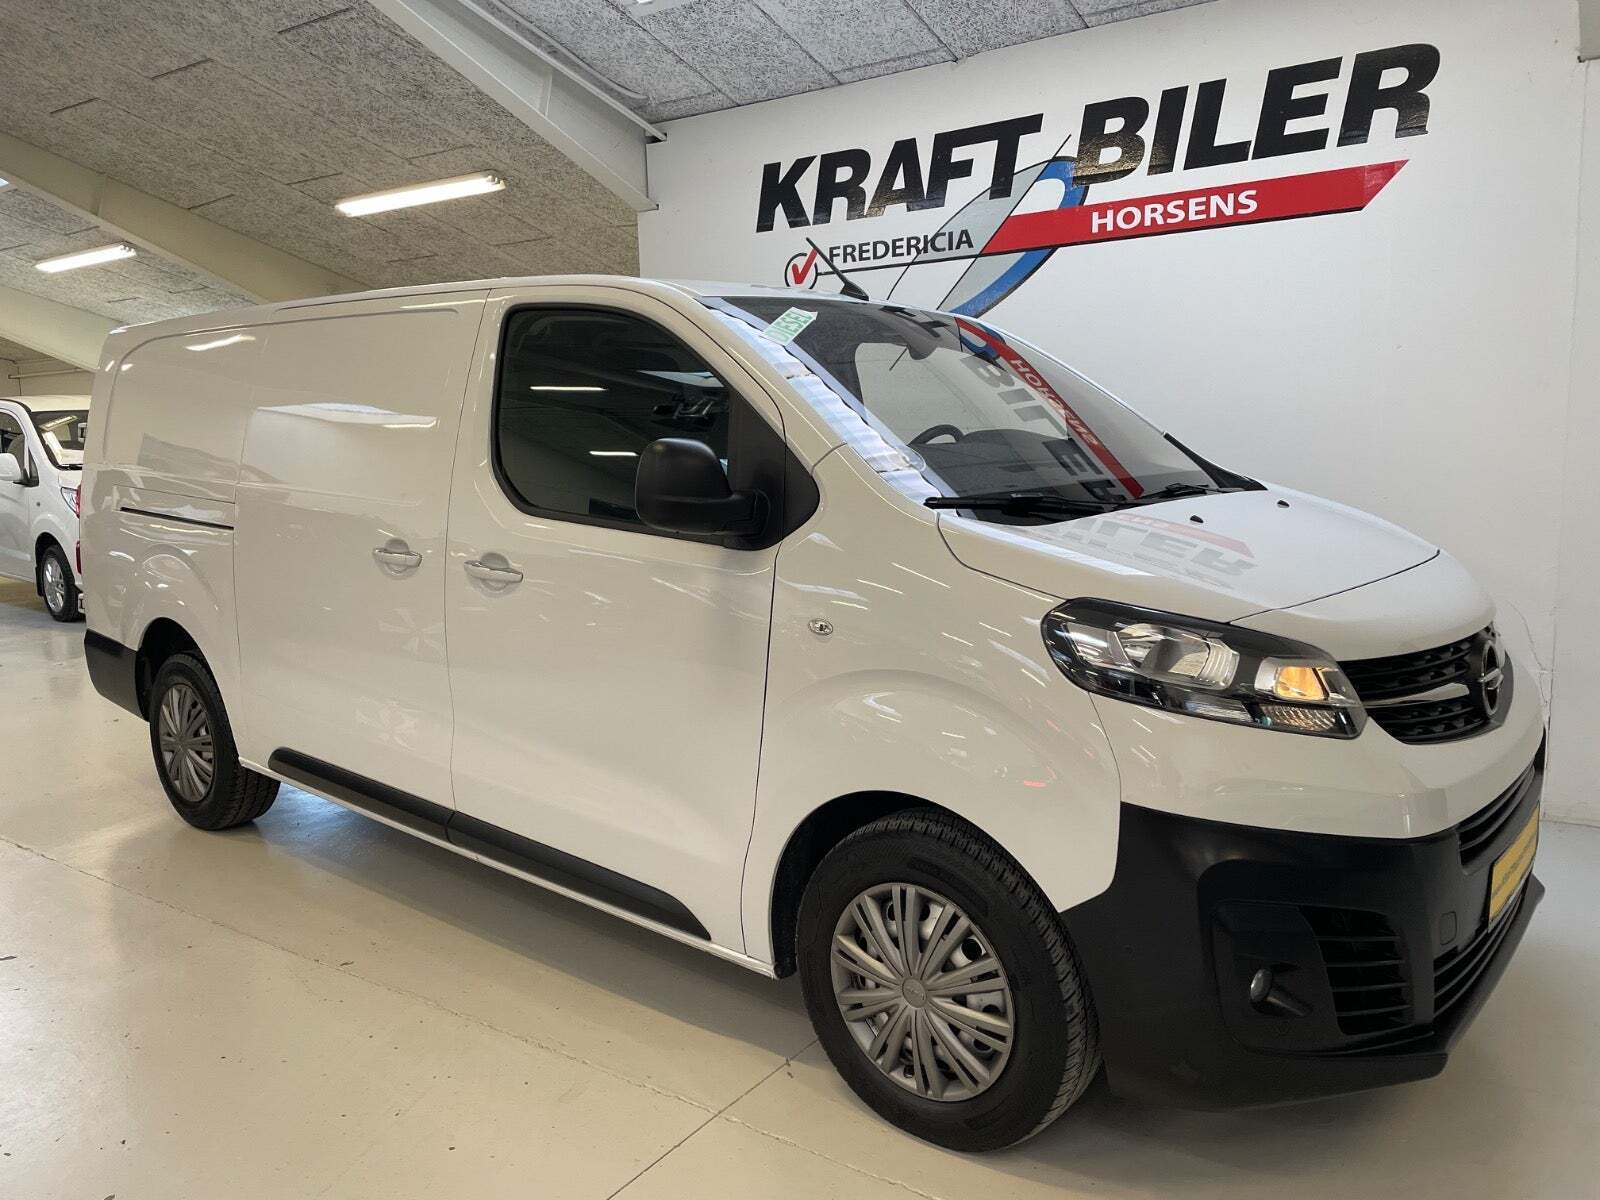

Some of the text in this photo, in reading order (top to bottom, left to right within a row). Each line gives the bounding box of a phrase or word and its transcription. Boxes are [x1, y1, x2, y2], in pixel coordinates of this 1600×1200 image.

[756, 43, 1441, 232] KRAFT BILER
[1091, 189, 1259, 233] HORSENS
[828, 229, 975, 264] FREDERICIA
